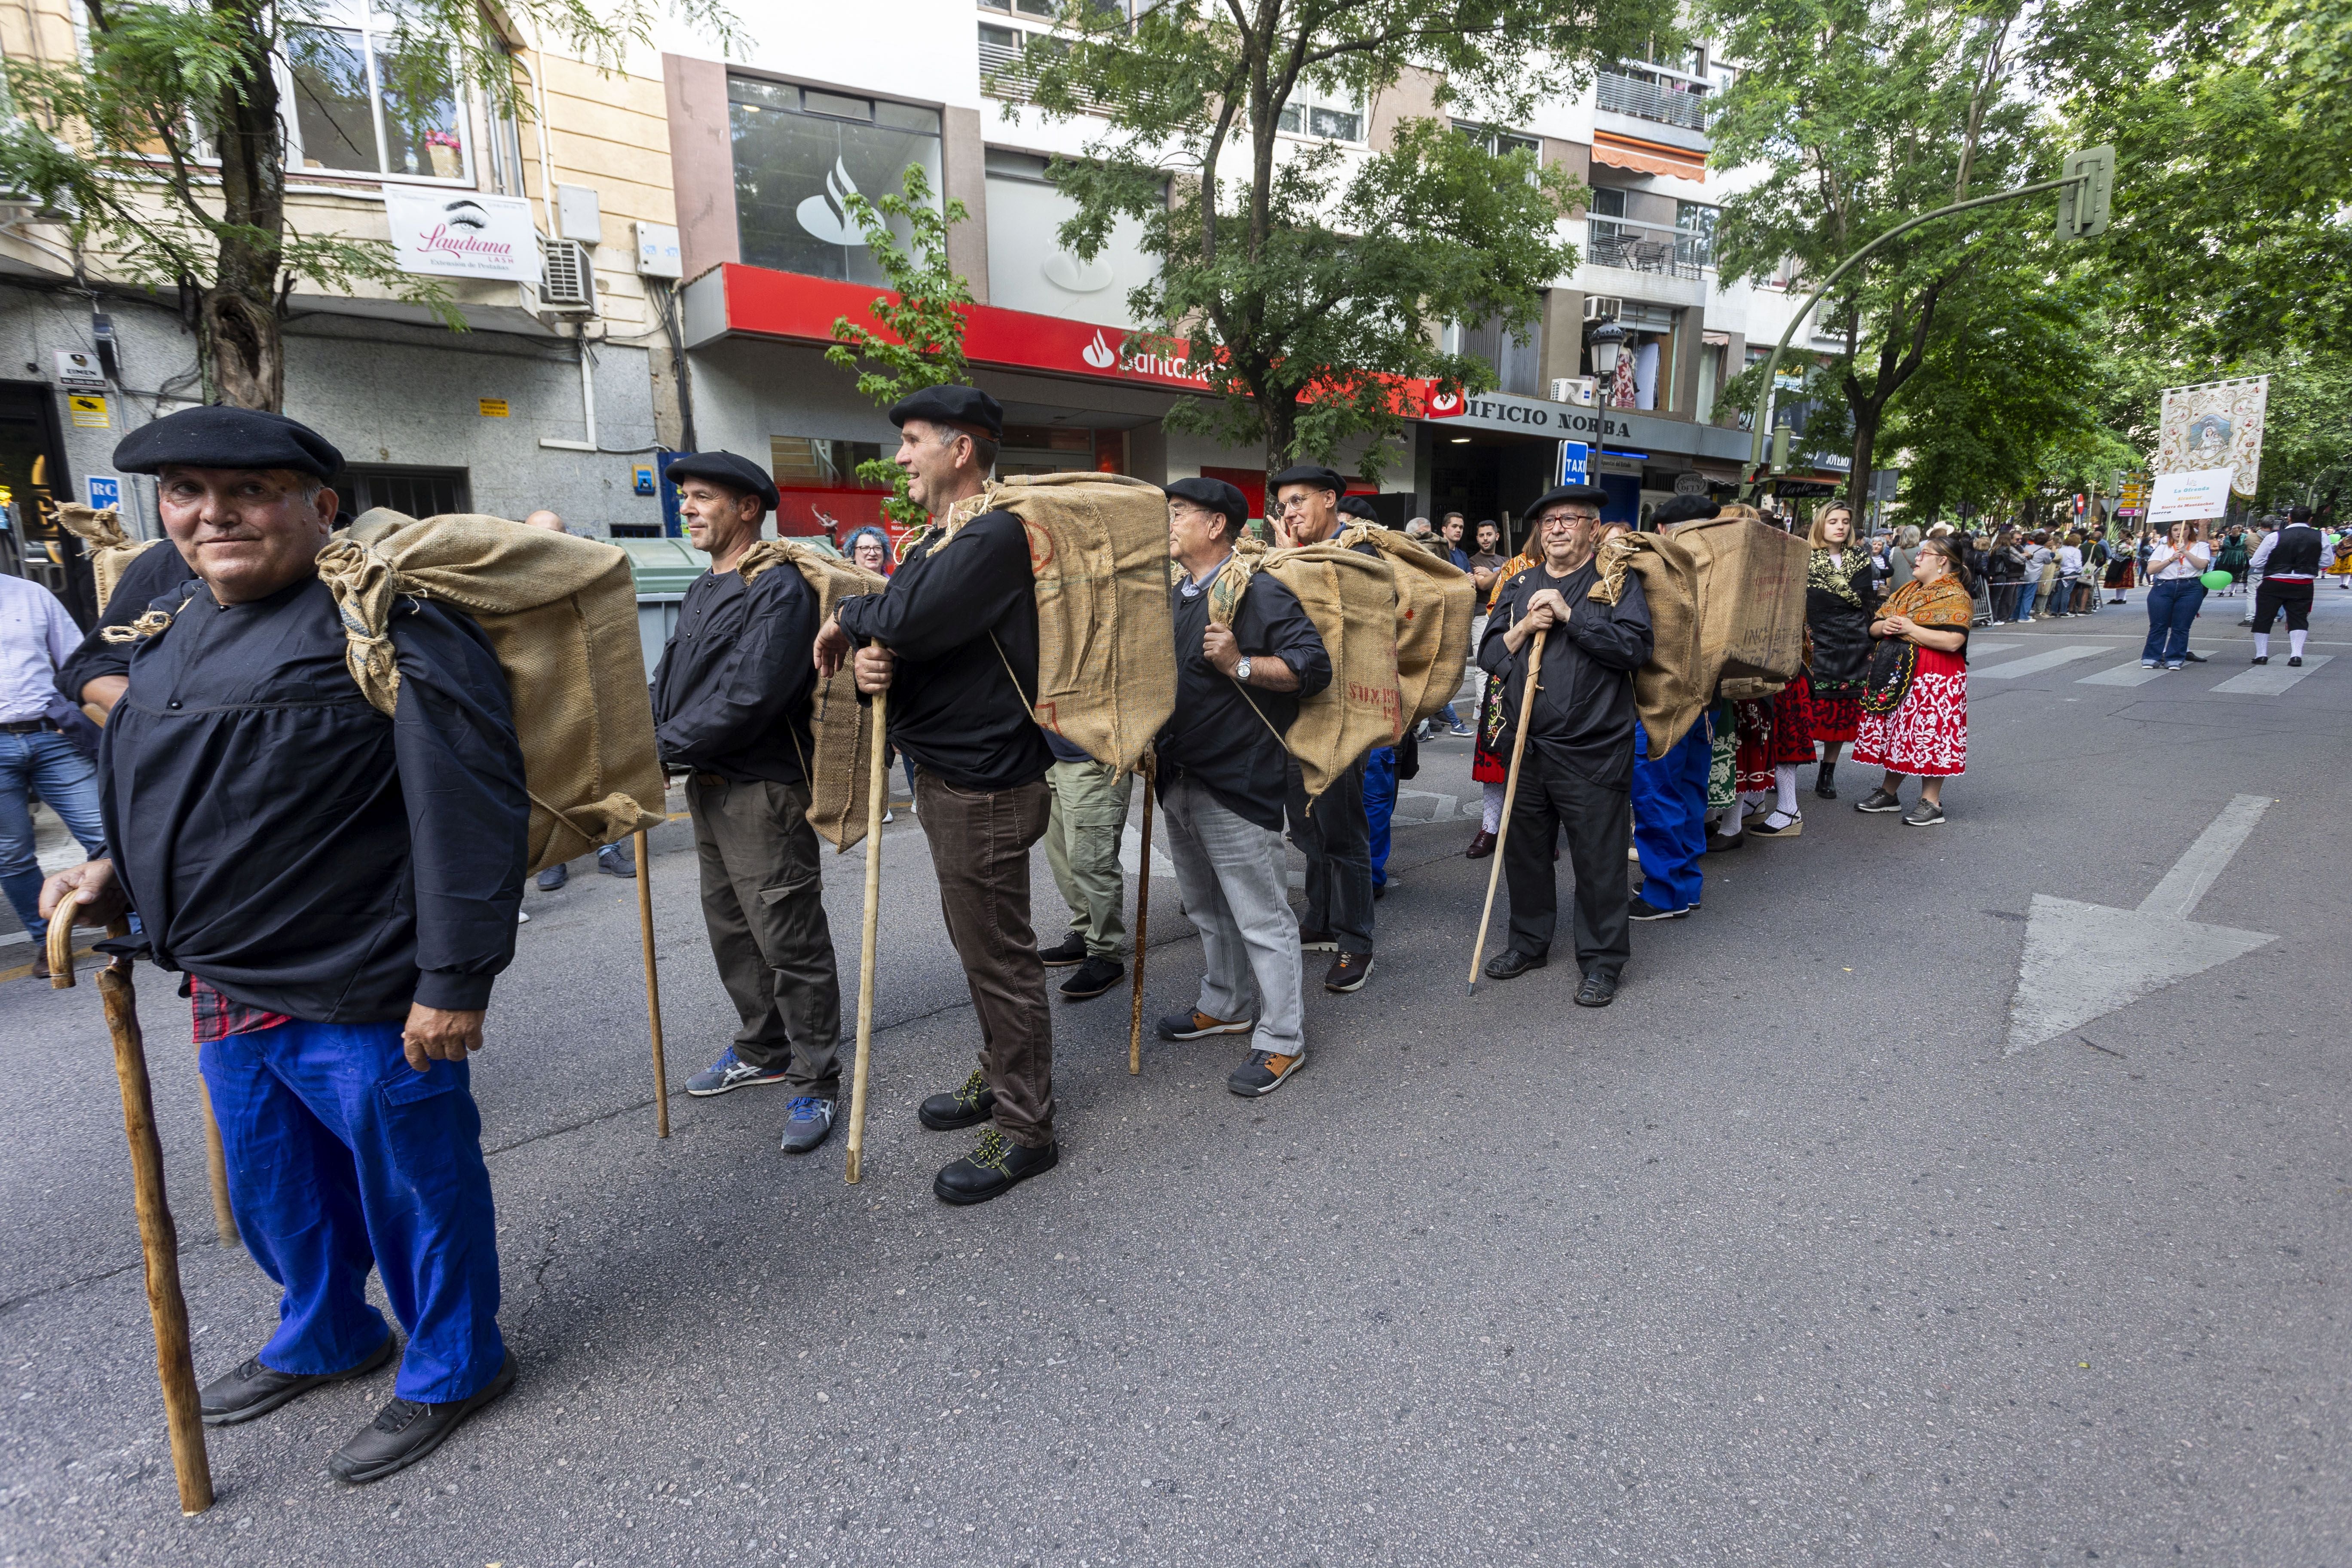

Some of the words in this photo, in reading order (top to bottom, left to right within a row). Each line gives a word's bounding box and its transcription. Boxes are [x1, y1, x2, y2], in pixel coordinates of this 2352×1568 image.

[416, 223, 511, 258] Laudiana
[430, 258, 466, 267] Extensión
[478, 262, 509, 271] Pestañas
[1119, 343, 1230, 386] Santand
[1464, 399, 1548, 426] IFICIO
[380, 448, 389, 460] 9
[1566, 459, 1586, 473] TAXI
[91, 482, 117, 497] RC
